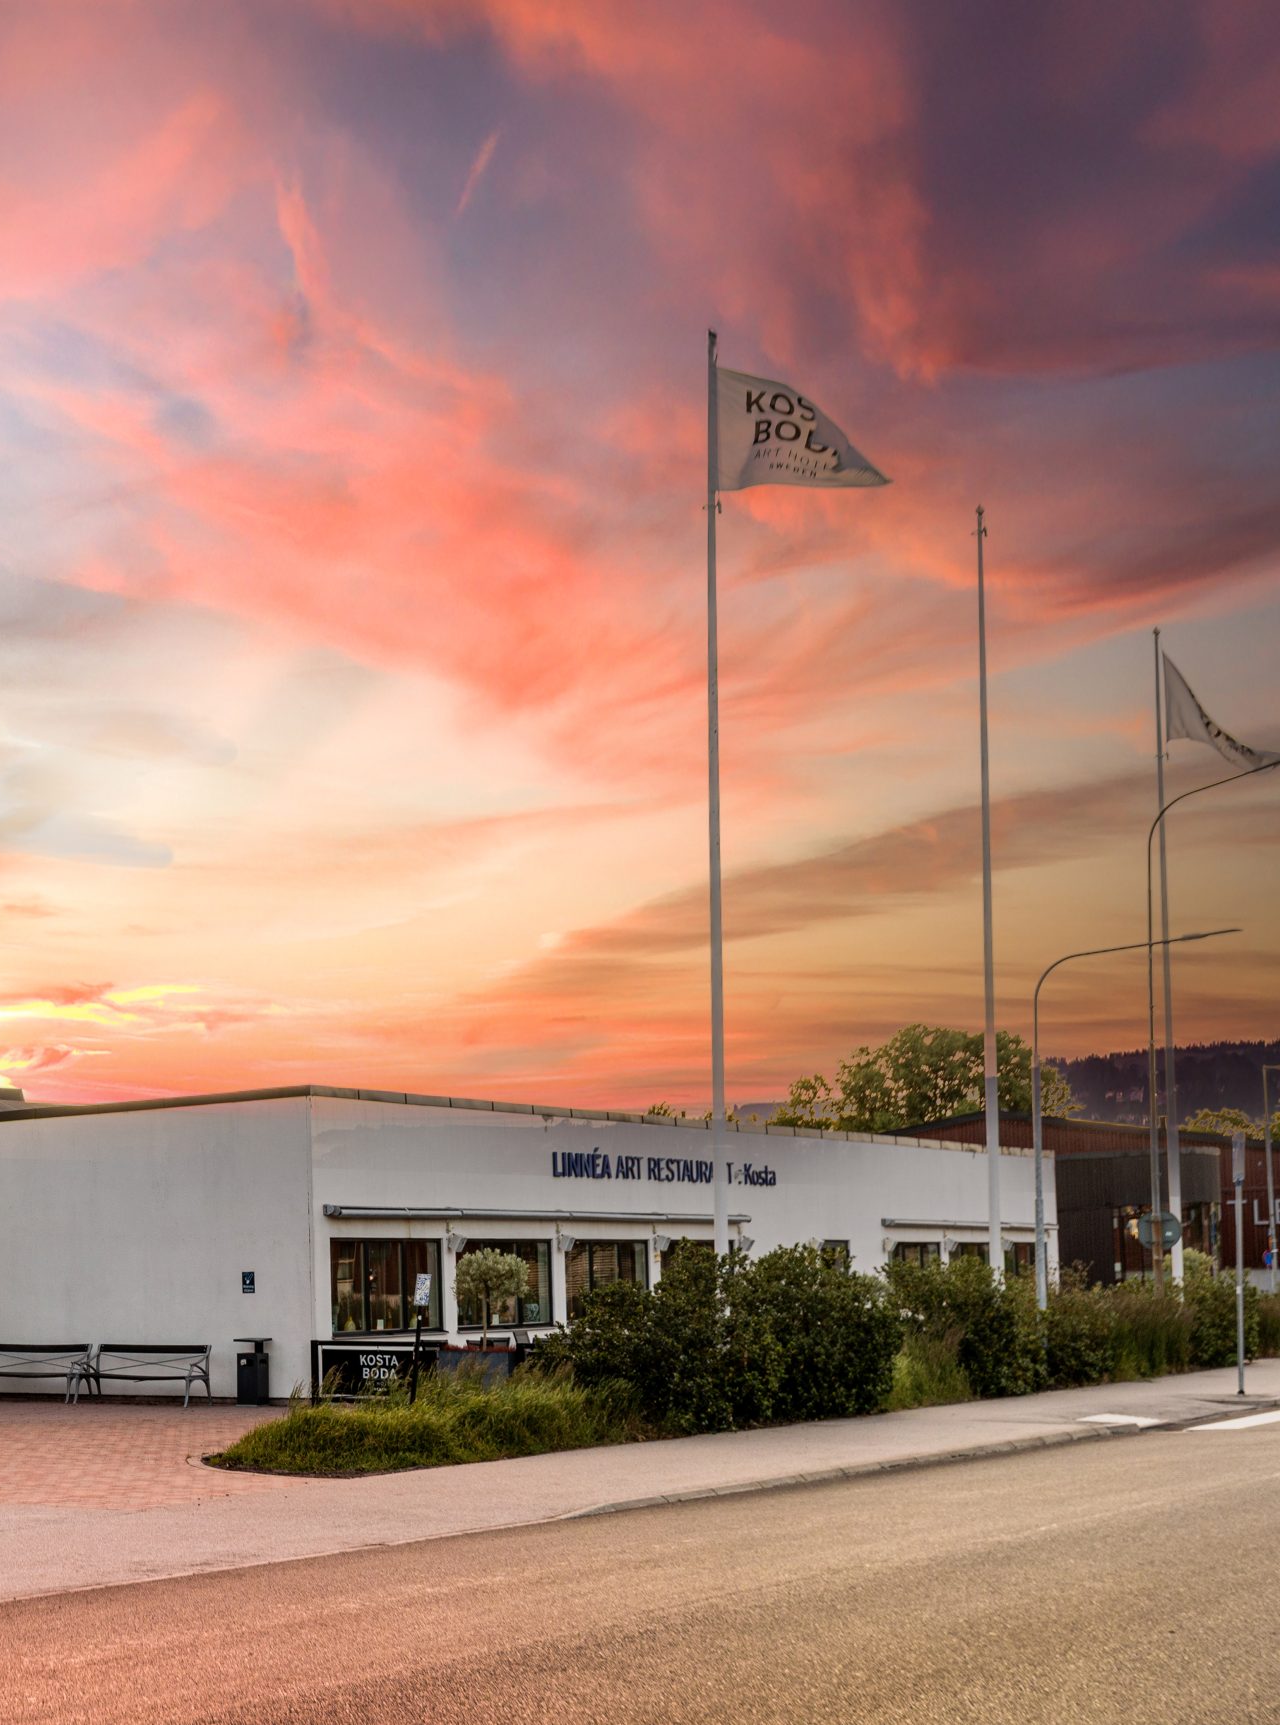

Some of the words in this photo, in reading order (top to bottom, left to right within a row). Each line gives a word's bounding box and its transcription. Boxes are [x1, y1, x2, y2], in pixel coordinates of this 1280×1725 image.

[745, 390, 816, 421] KOS
[552, 1147, 612, 1180] LINNÉA
[616, 1155, 644, 1181] ART
[647, 1157, 734, 1184] RESTAURAT
[359, 1354, 399, 1366] KOSTA
[362, 1367, 397, 1379] BODA
